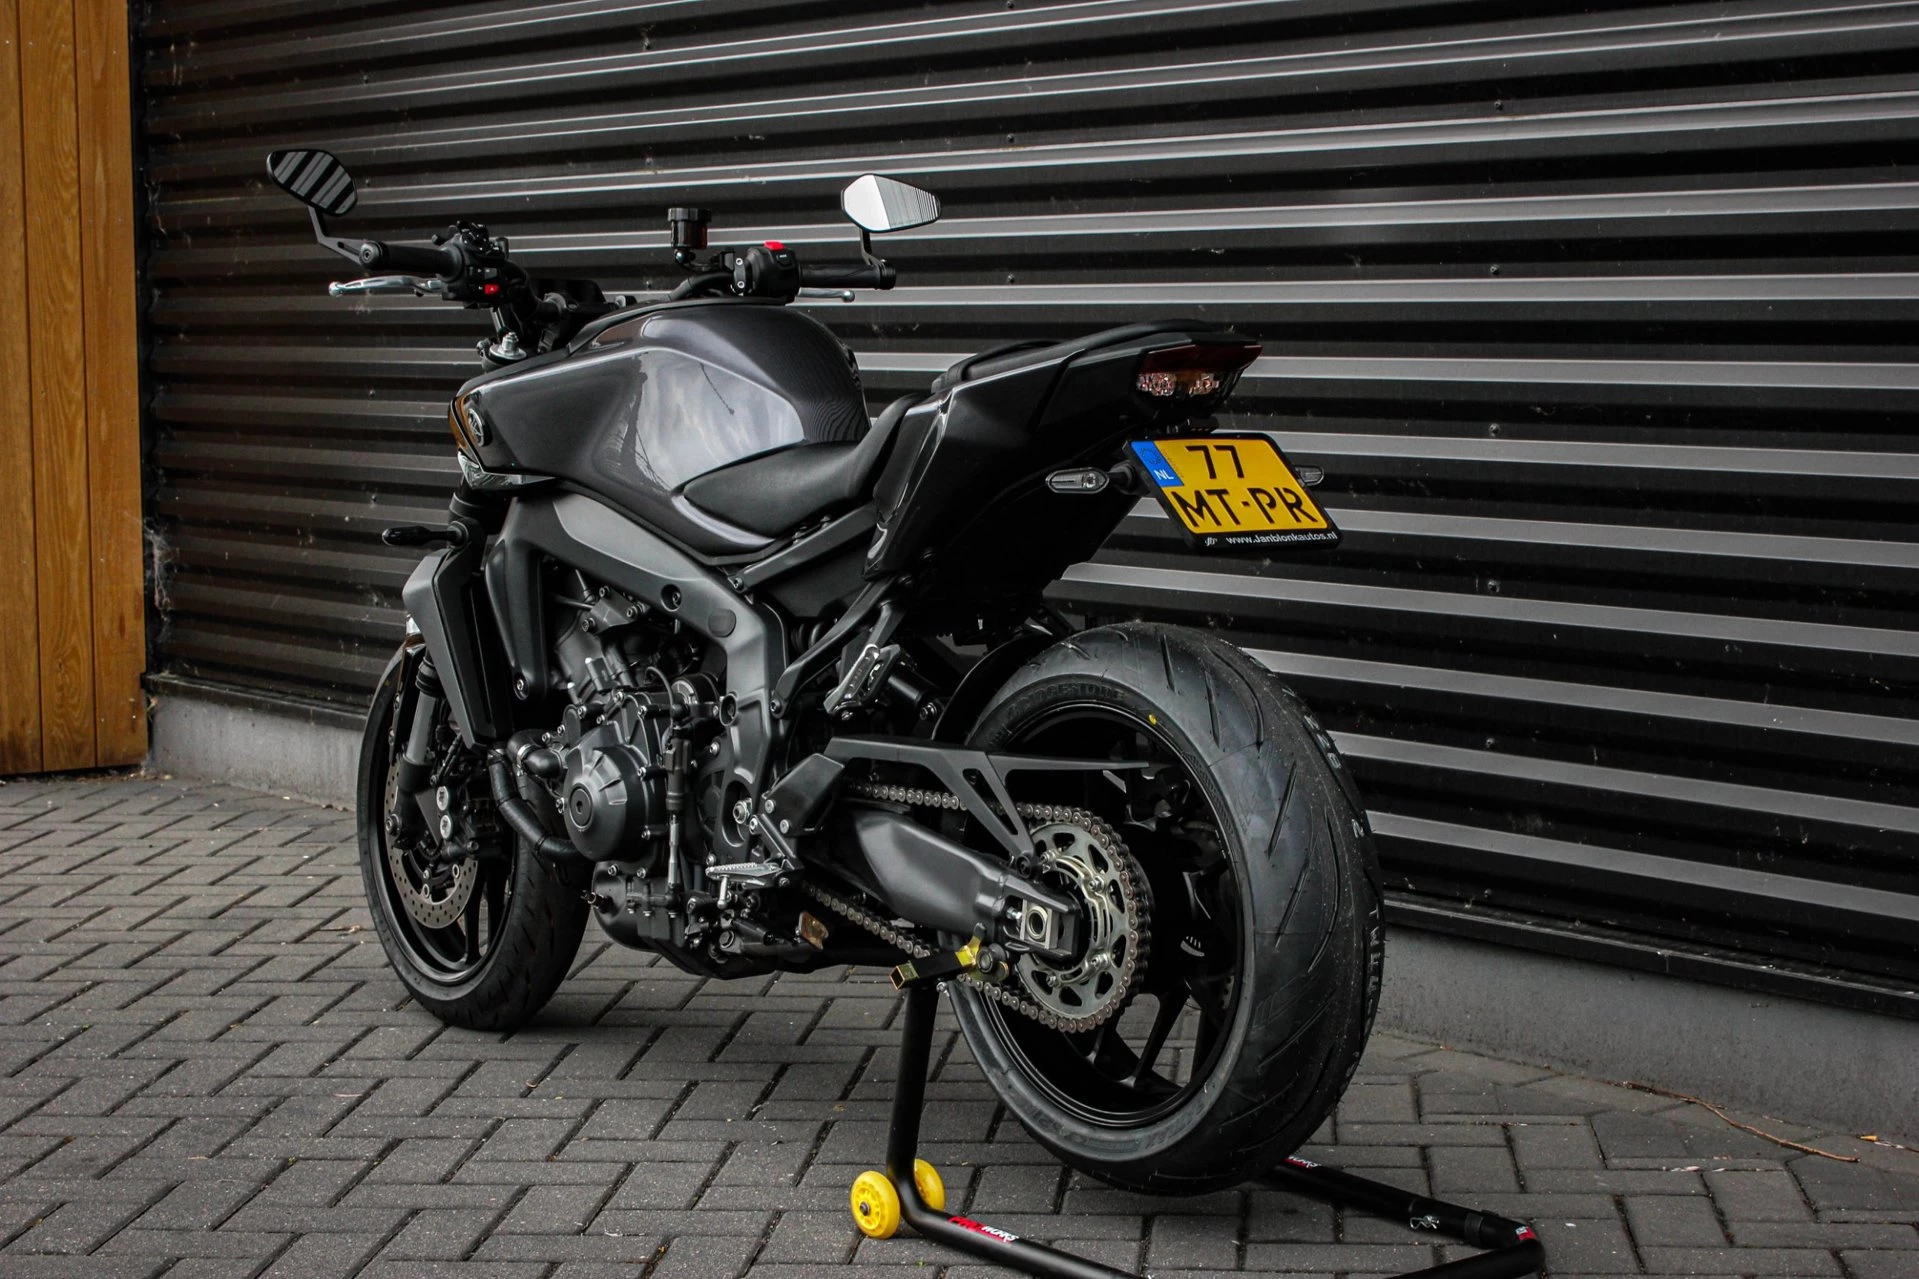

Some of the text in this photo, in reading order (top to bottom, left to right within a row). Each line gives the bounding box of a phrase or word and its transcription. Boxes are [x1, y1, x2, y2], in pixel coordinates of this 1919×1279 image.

[1154, 469, 1174, 481] NL
[1186, 445, 1245, 479] 77
[1171, 487, 1318, 527] MT-PR
